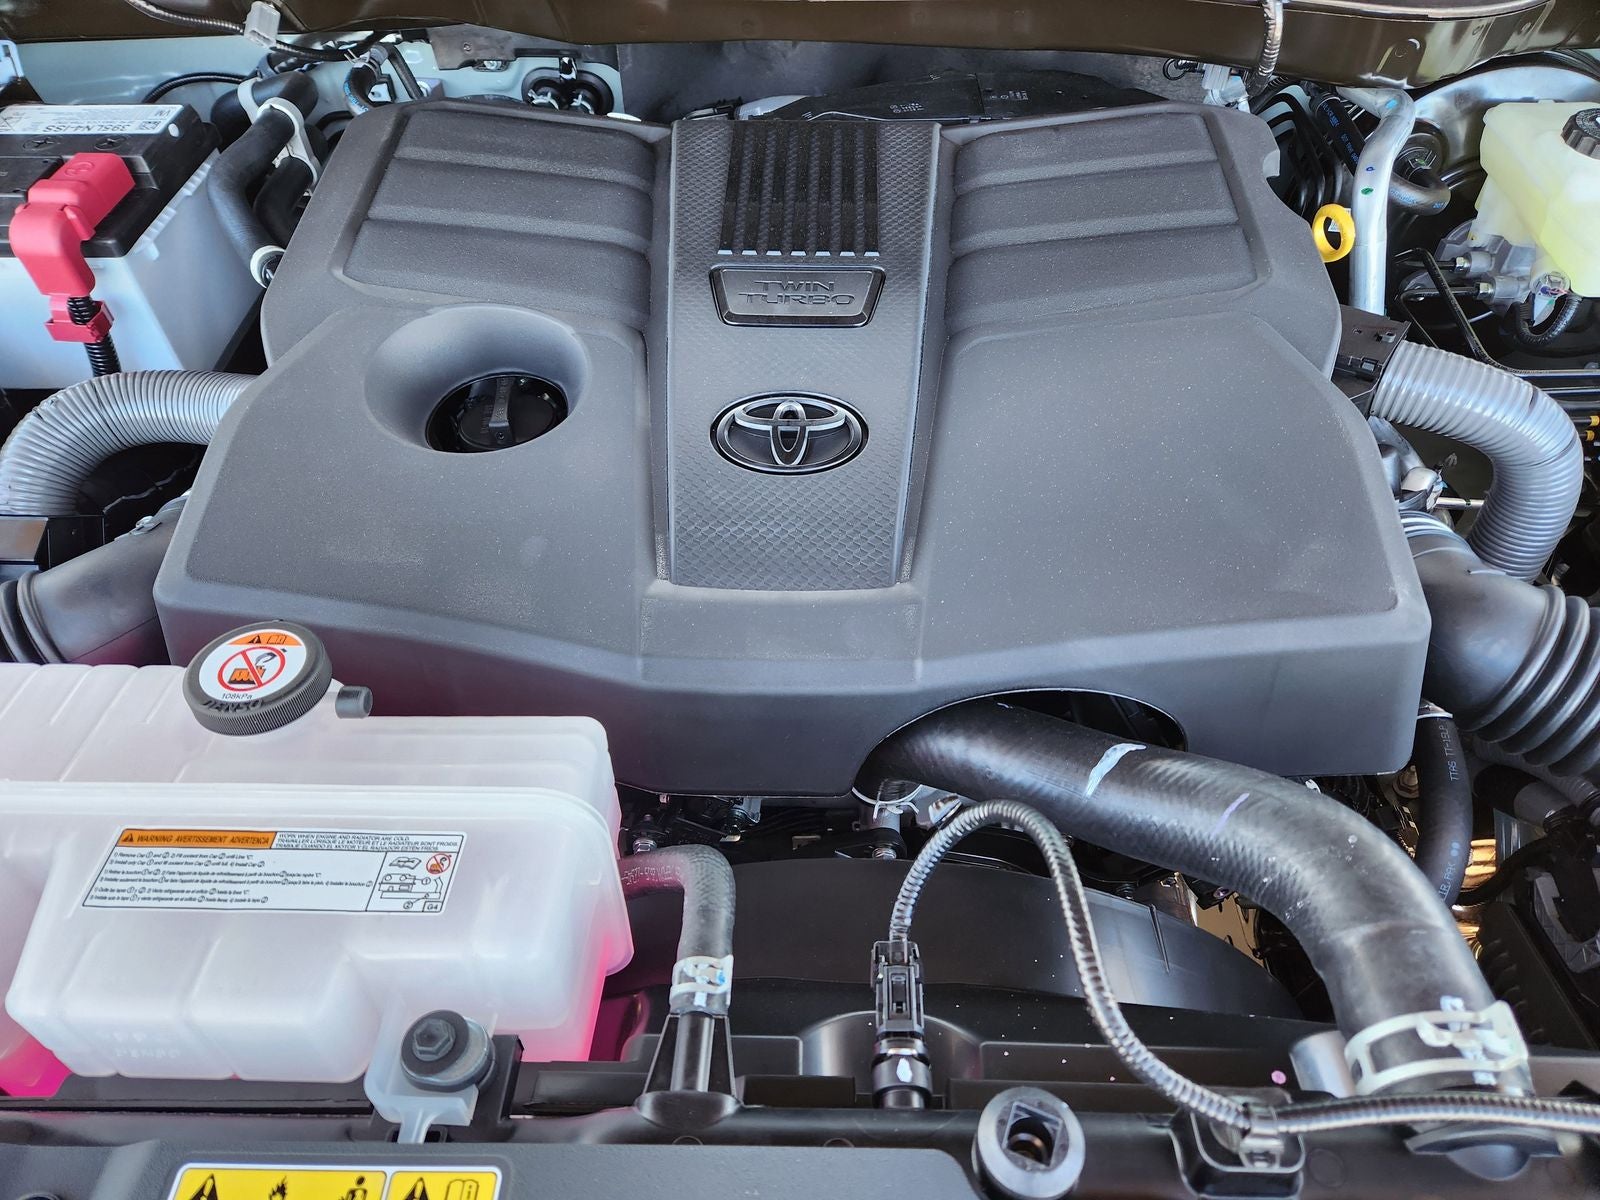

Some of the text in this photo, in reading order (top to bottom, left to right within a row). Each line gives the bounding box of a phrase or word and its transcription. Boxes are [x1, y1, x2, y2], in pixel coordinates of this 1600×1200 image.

[754, 280, 835, 292] TWIN
[738, 292, 855, 305] TURBO
[174, 835, 228, 843] AVERTISSEMENT
